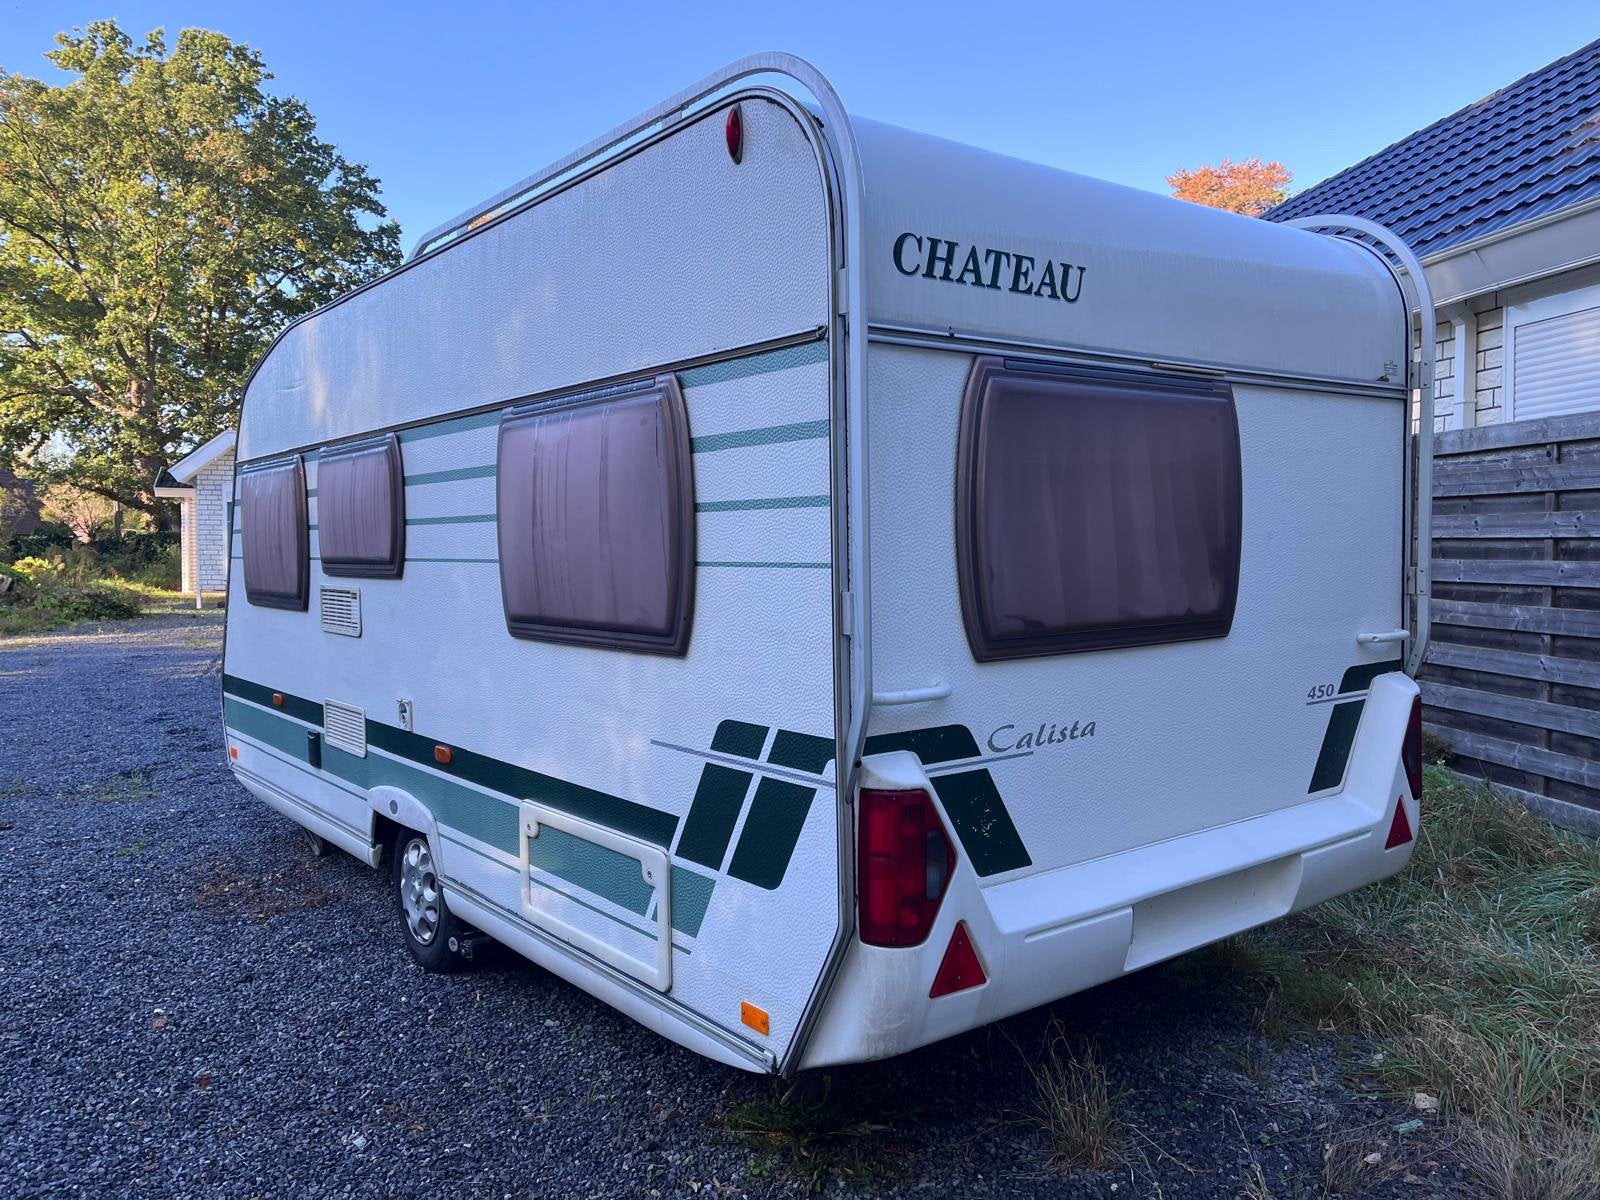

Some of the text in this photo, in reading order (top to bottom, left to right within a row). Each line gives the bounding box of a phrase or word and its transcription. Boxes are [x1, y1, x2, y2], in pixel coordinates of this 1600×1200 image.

[893, 232, 1086, 304] CHATEAU
[1307, 683, 1335, 699] 450
[987, 720, 1096, 753] Calista
